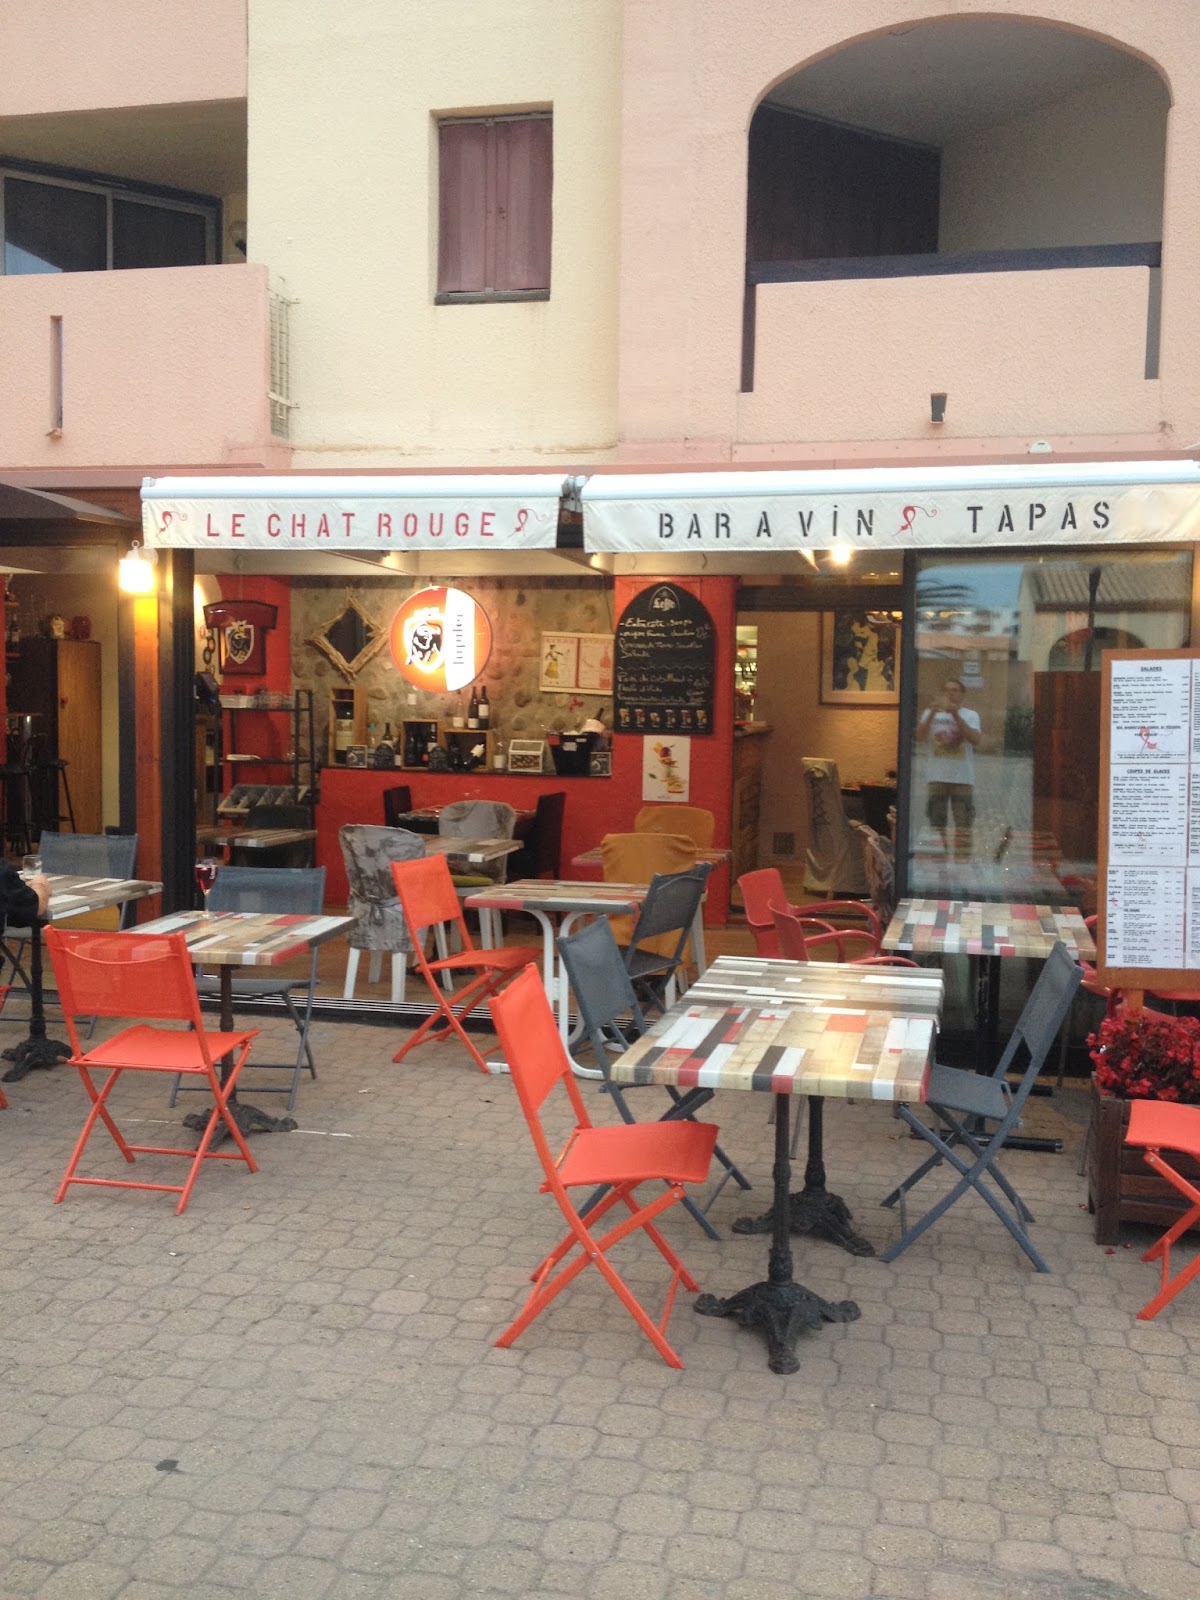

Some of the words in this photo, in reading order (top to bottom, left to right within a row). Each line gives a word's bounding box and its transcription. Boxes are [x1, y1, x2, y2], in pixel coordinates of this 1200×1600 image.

[206, 513, 246, 537] LE
[267, 512, 355, 538] CHAT
[377, 511, 496, 538] ROUGE
[658, 512, 732, 539] BAR
[756, 510, 772, 538] A
[966, 501, 1100, 534] TAPAS
